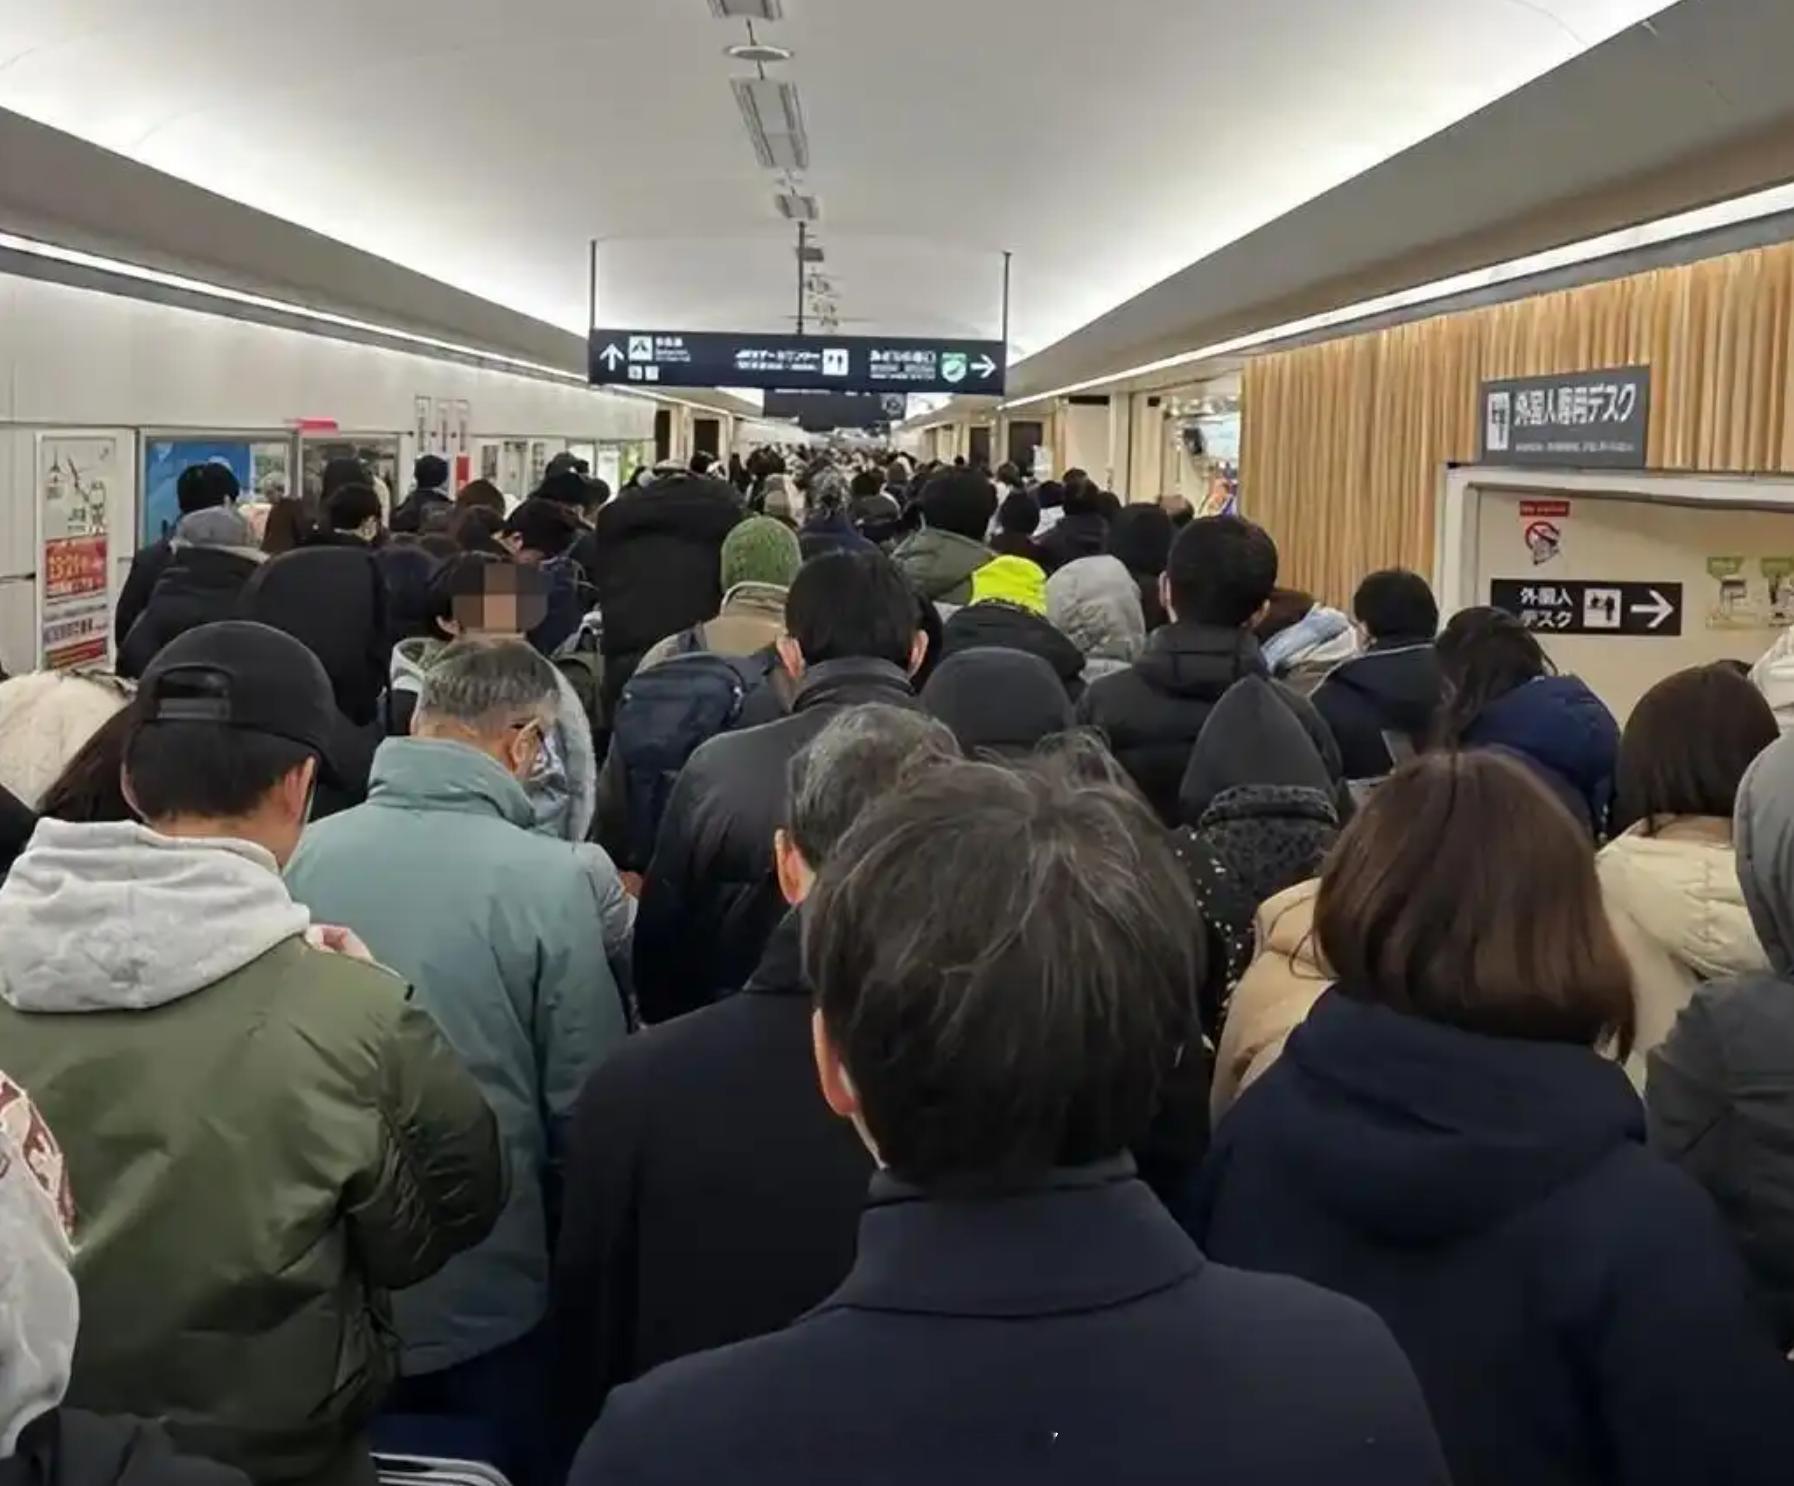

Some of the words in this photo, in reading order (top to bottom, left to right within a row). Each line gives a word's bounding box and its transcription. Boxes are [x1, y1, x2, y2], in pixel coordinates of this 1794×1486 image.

[1520, 587, 1574, 608] 外国人
[1522, 609, 1572, 629] デスク
